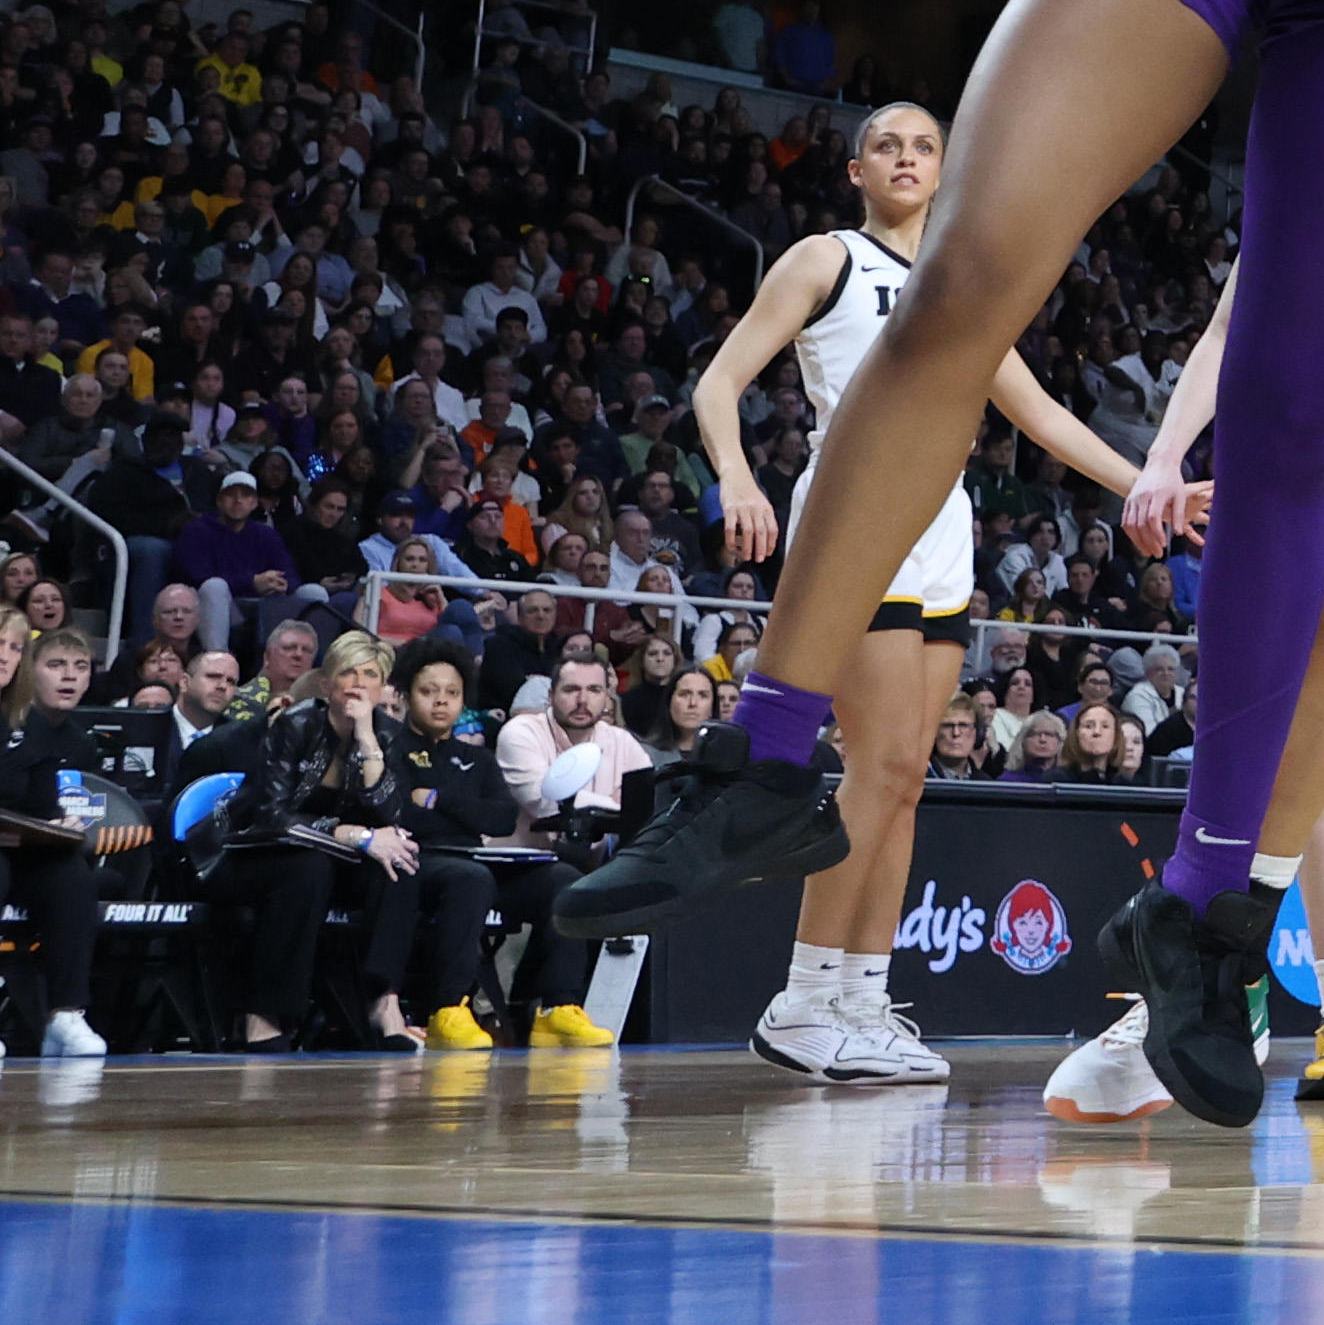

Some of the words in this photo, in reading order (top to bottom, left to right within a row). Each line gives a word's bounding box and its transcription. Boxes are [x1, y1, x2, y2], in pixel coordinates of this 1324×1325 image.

[104, 904, 144, 922] FOUR
[146, 905, 161, 921] IT
[162, 904, 189, 922] ALL
